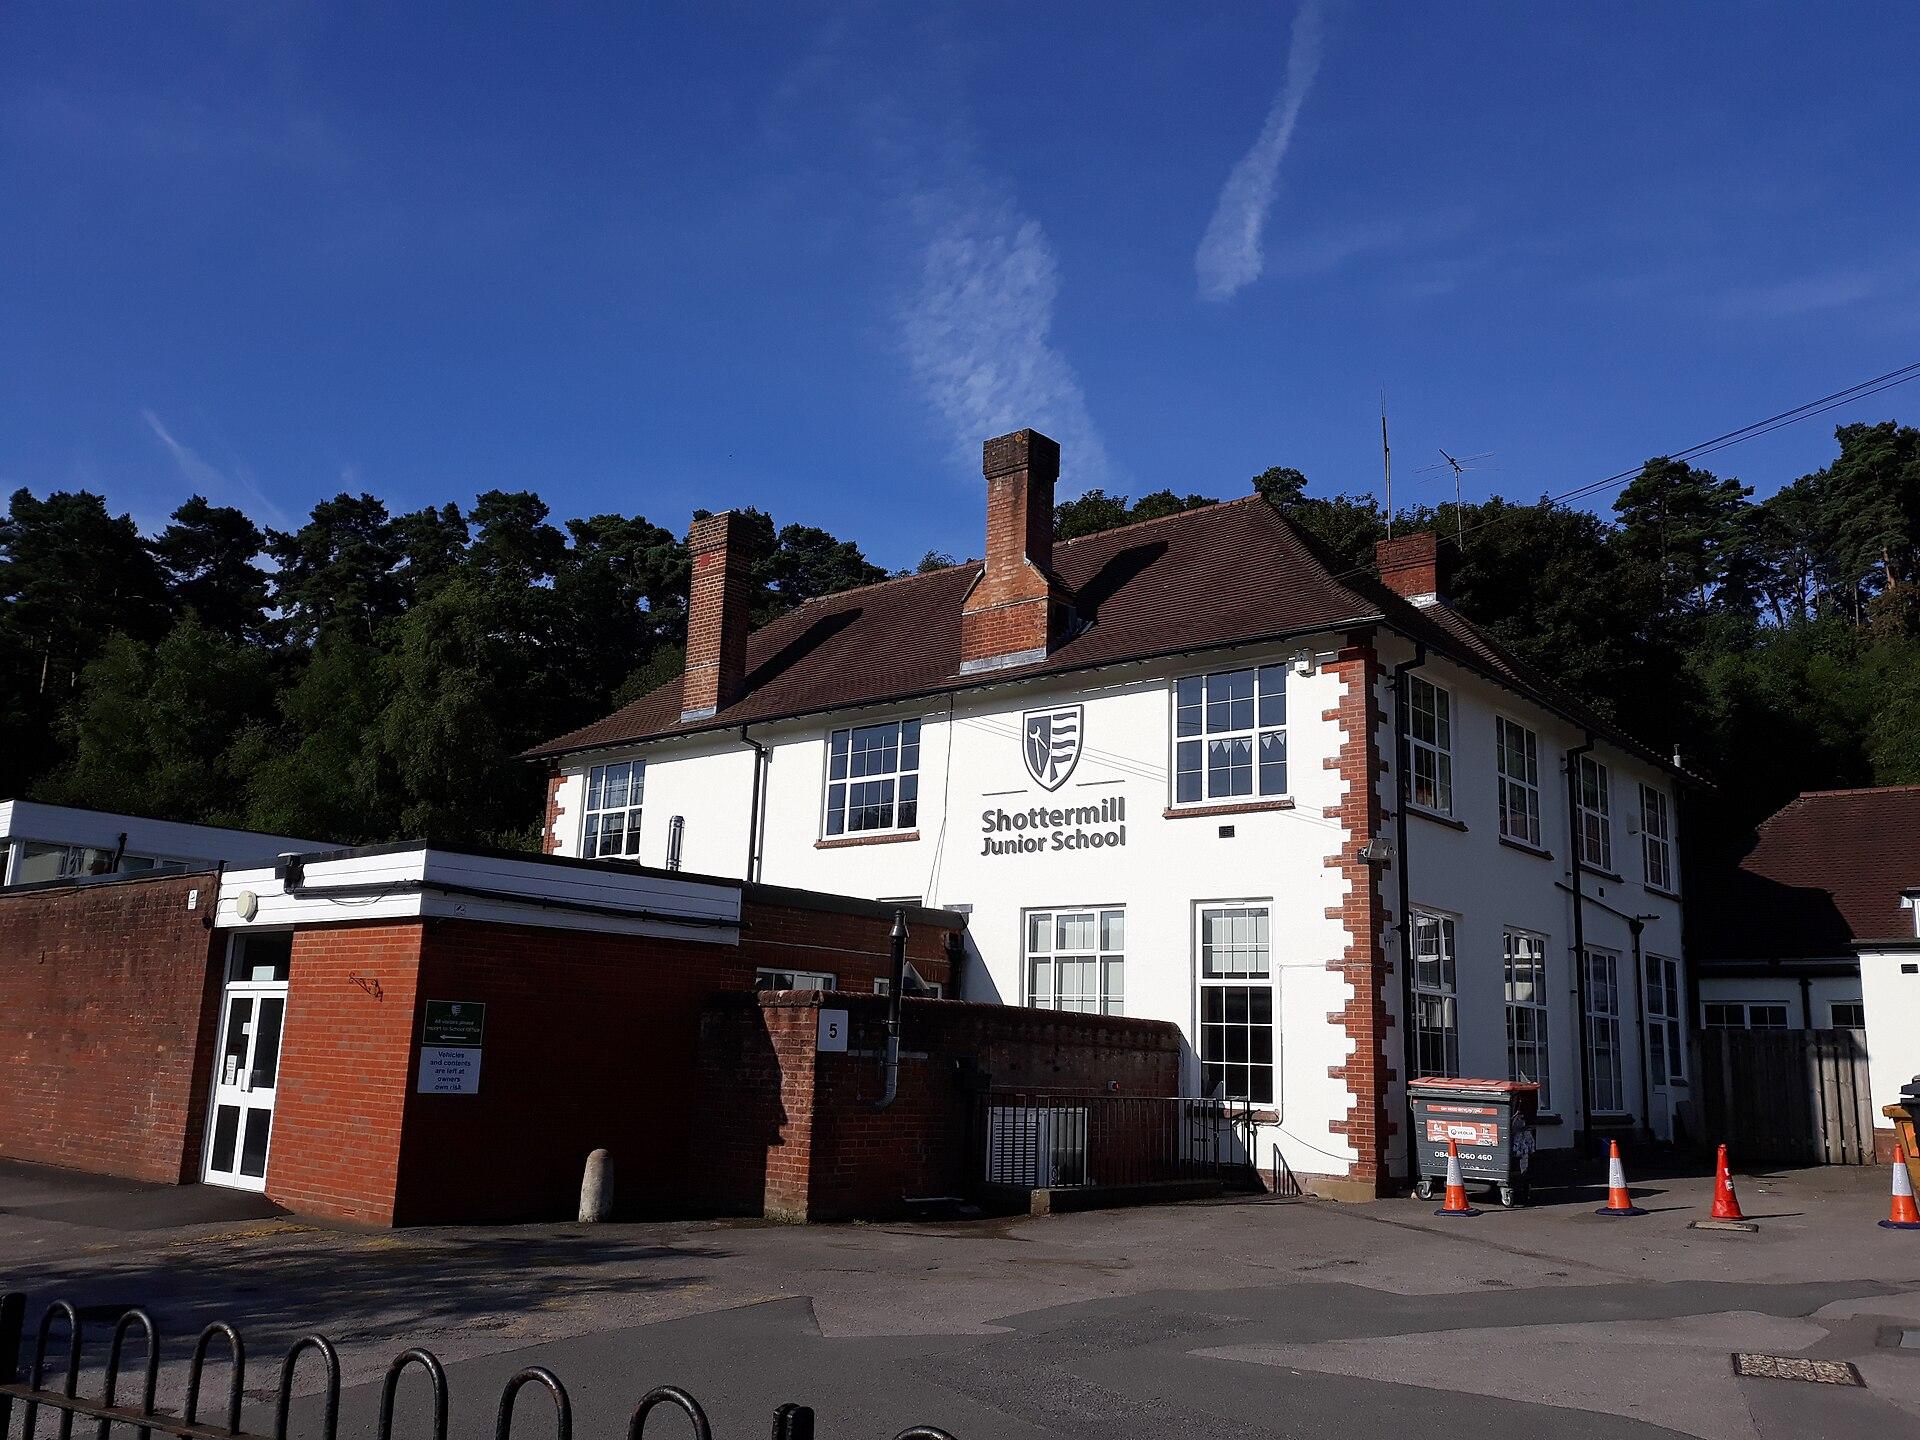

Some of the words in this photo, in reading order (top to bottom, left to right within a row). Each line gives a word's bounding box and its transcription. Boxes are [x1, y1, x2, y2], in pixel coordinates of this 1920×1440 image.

[981, 796, 1125, 833] Shottermill
[980, 833, 1047, 856] Junior
[1051, 825, 1125, 851] School
[829, 1023, 838, 1039] 5
